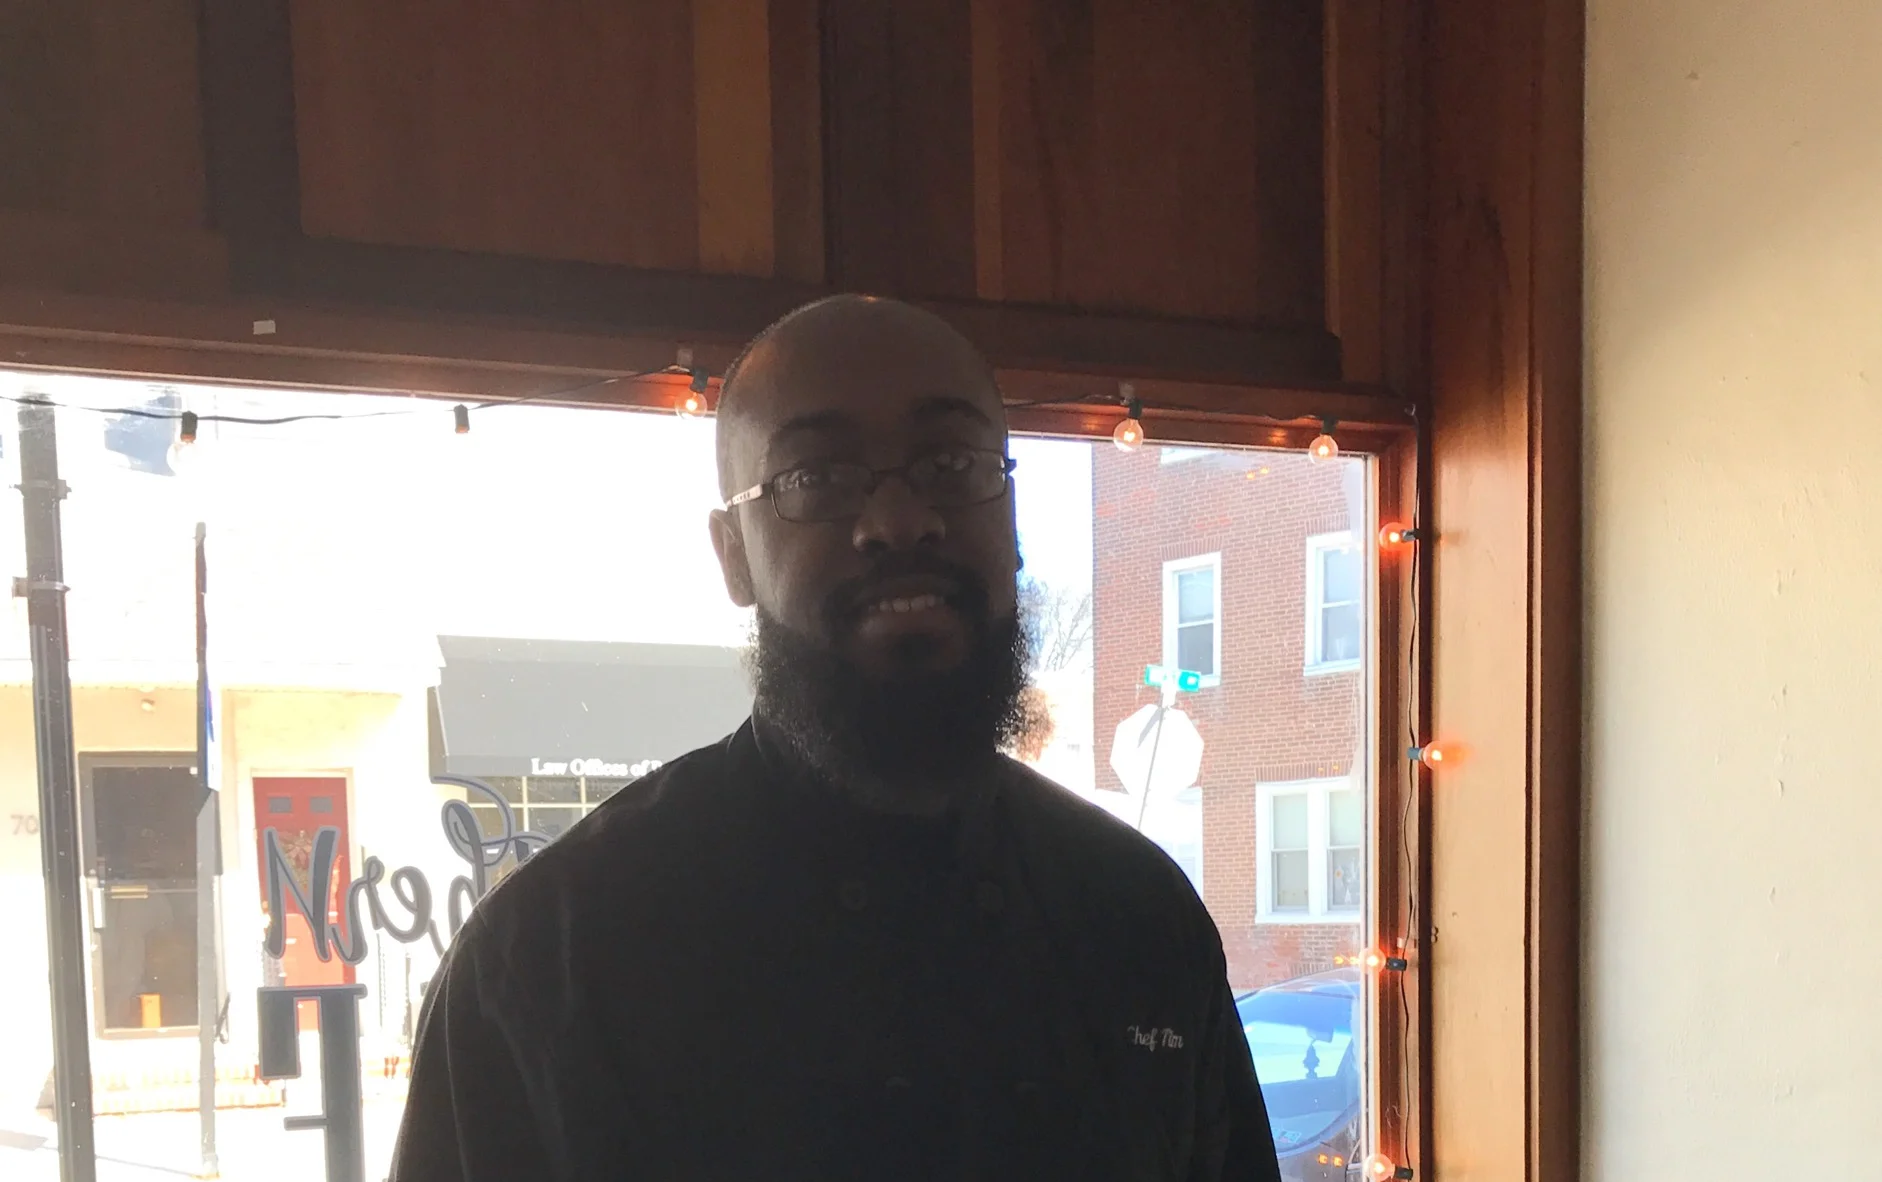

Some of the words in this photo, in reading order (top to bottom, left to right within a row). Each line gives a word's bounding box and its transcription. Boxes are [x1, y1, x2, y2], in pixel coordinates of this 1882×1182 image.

[531, 758, 568, 775] Law
[570, 758, 629, 776] Offices
[630, 759, 651, 776] of
